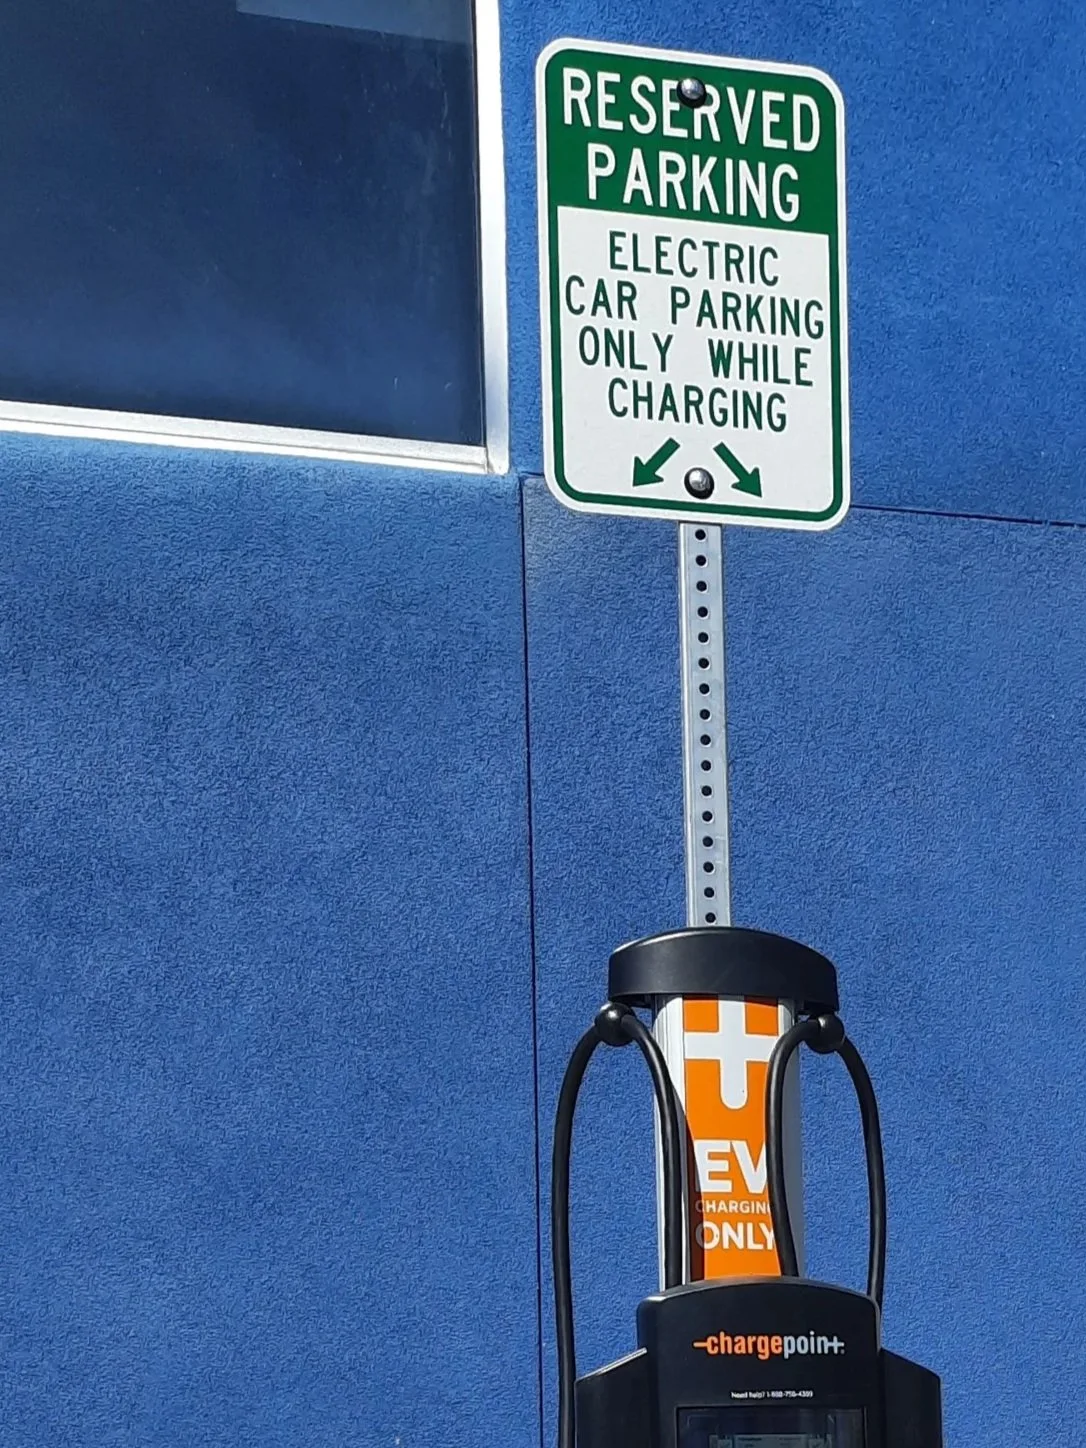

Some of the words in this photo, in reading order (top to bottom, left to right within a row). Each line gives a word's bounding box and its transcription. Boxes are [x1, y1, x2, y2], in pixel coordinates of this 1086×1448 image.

[562, 66, 821, 152] RESERVED
[586, 142, 800, 223] PARKING
[608, 230, 780, 287] ELECTRIC
[564, 274, 638, 322] CAR
[670, 285, 825, 340] PARKING
[578, 325, 673, 373] ONLY
[708, 338, 813, 387] WHILE
[608, 376, 787, 433] CHARGING
[693, 1139, 768, 1194] EV
[695, 1199, 771, 1214] CHARGIN
[695, 1220, 775, 1250] ONLY
